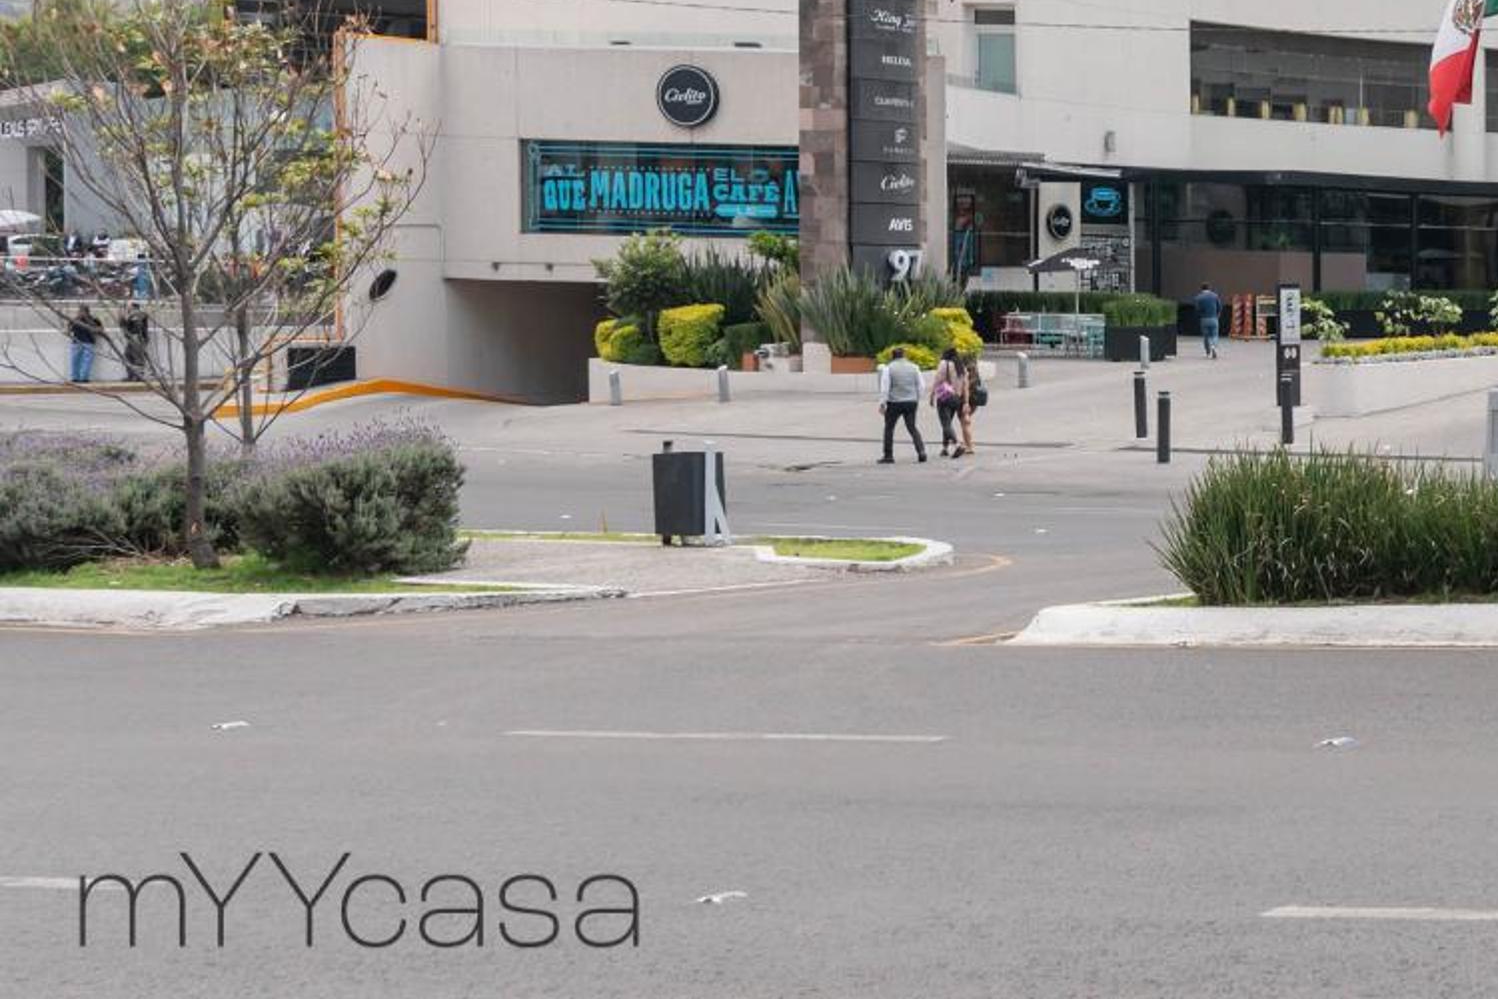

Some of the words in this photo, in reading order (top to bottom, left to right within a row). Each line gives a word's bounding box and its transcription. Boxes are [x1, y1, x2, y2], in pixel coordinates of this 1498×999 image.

[664, 88, 706, 105] Cielito
[714, 168, 744, 182] EL
[543, 179, 586, 211] QUE
[590, 170, 711, 211] MADRUGA
